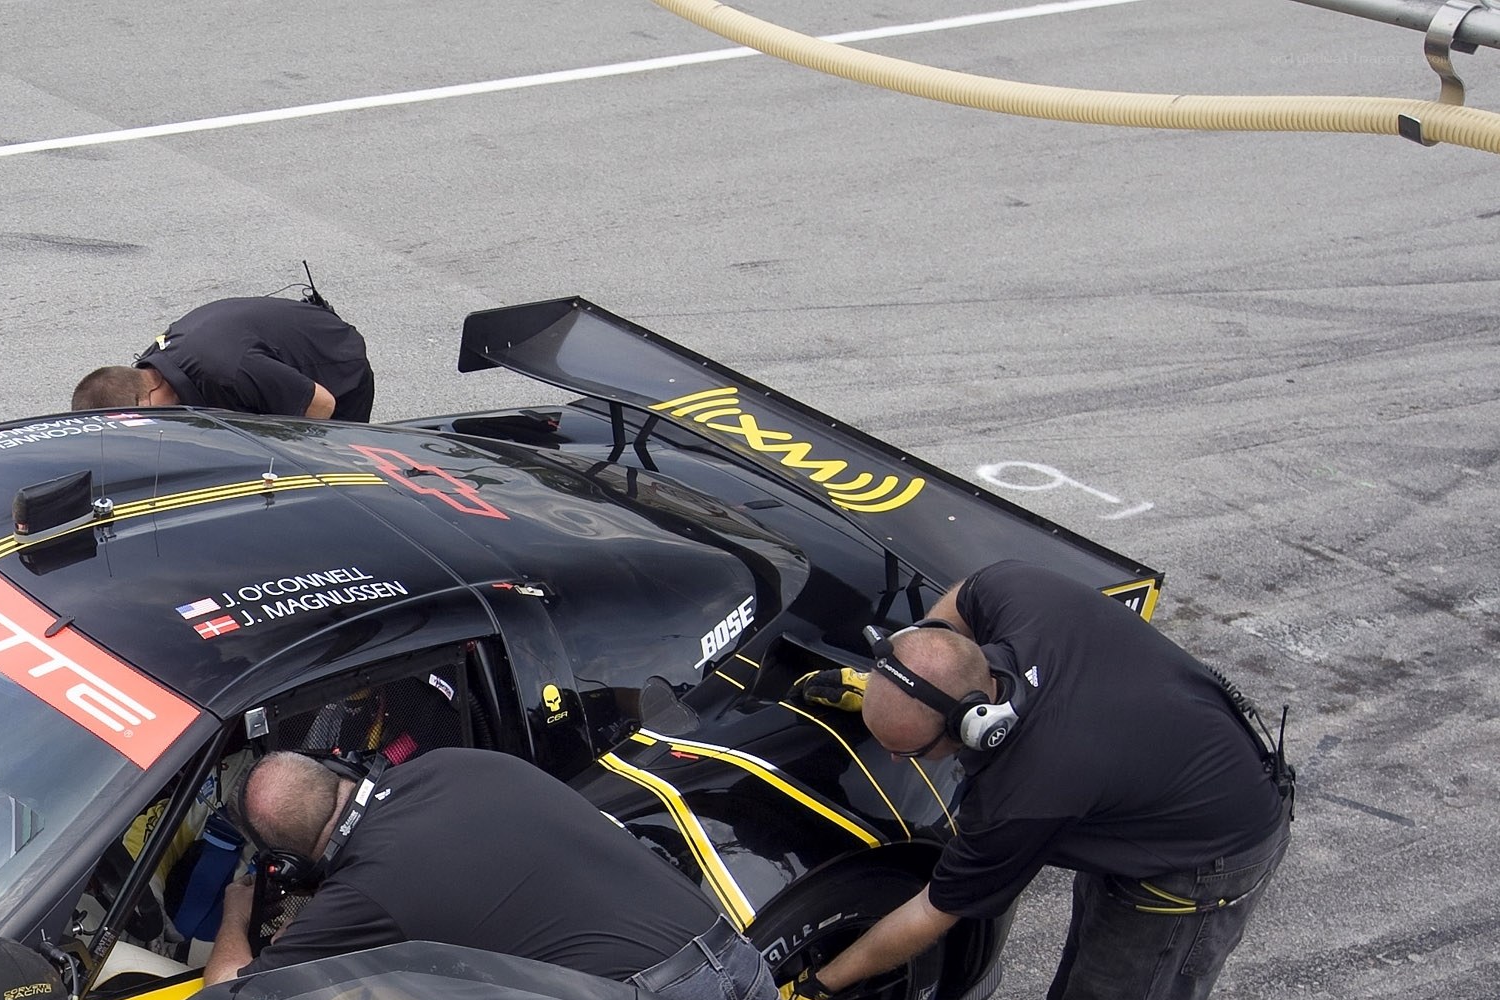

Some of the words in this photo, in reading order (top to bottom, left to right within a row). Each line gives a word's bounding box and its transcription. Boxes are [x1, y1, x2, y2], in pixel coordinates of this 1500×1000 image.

[221, 592, 241, 609] J.
[238, 566, 374, 602] O'CONNELL
[240, 609, 263, 627] J.
[262, 580, 409, 620] MAGNUSSEN
[694, 595, 754, 669] BOSE
[883, 664, 916, 688] MOTOROLA
[3, 983, 52, 997] CORVETTE
